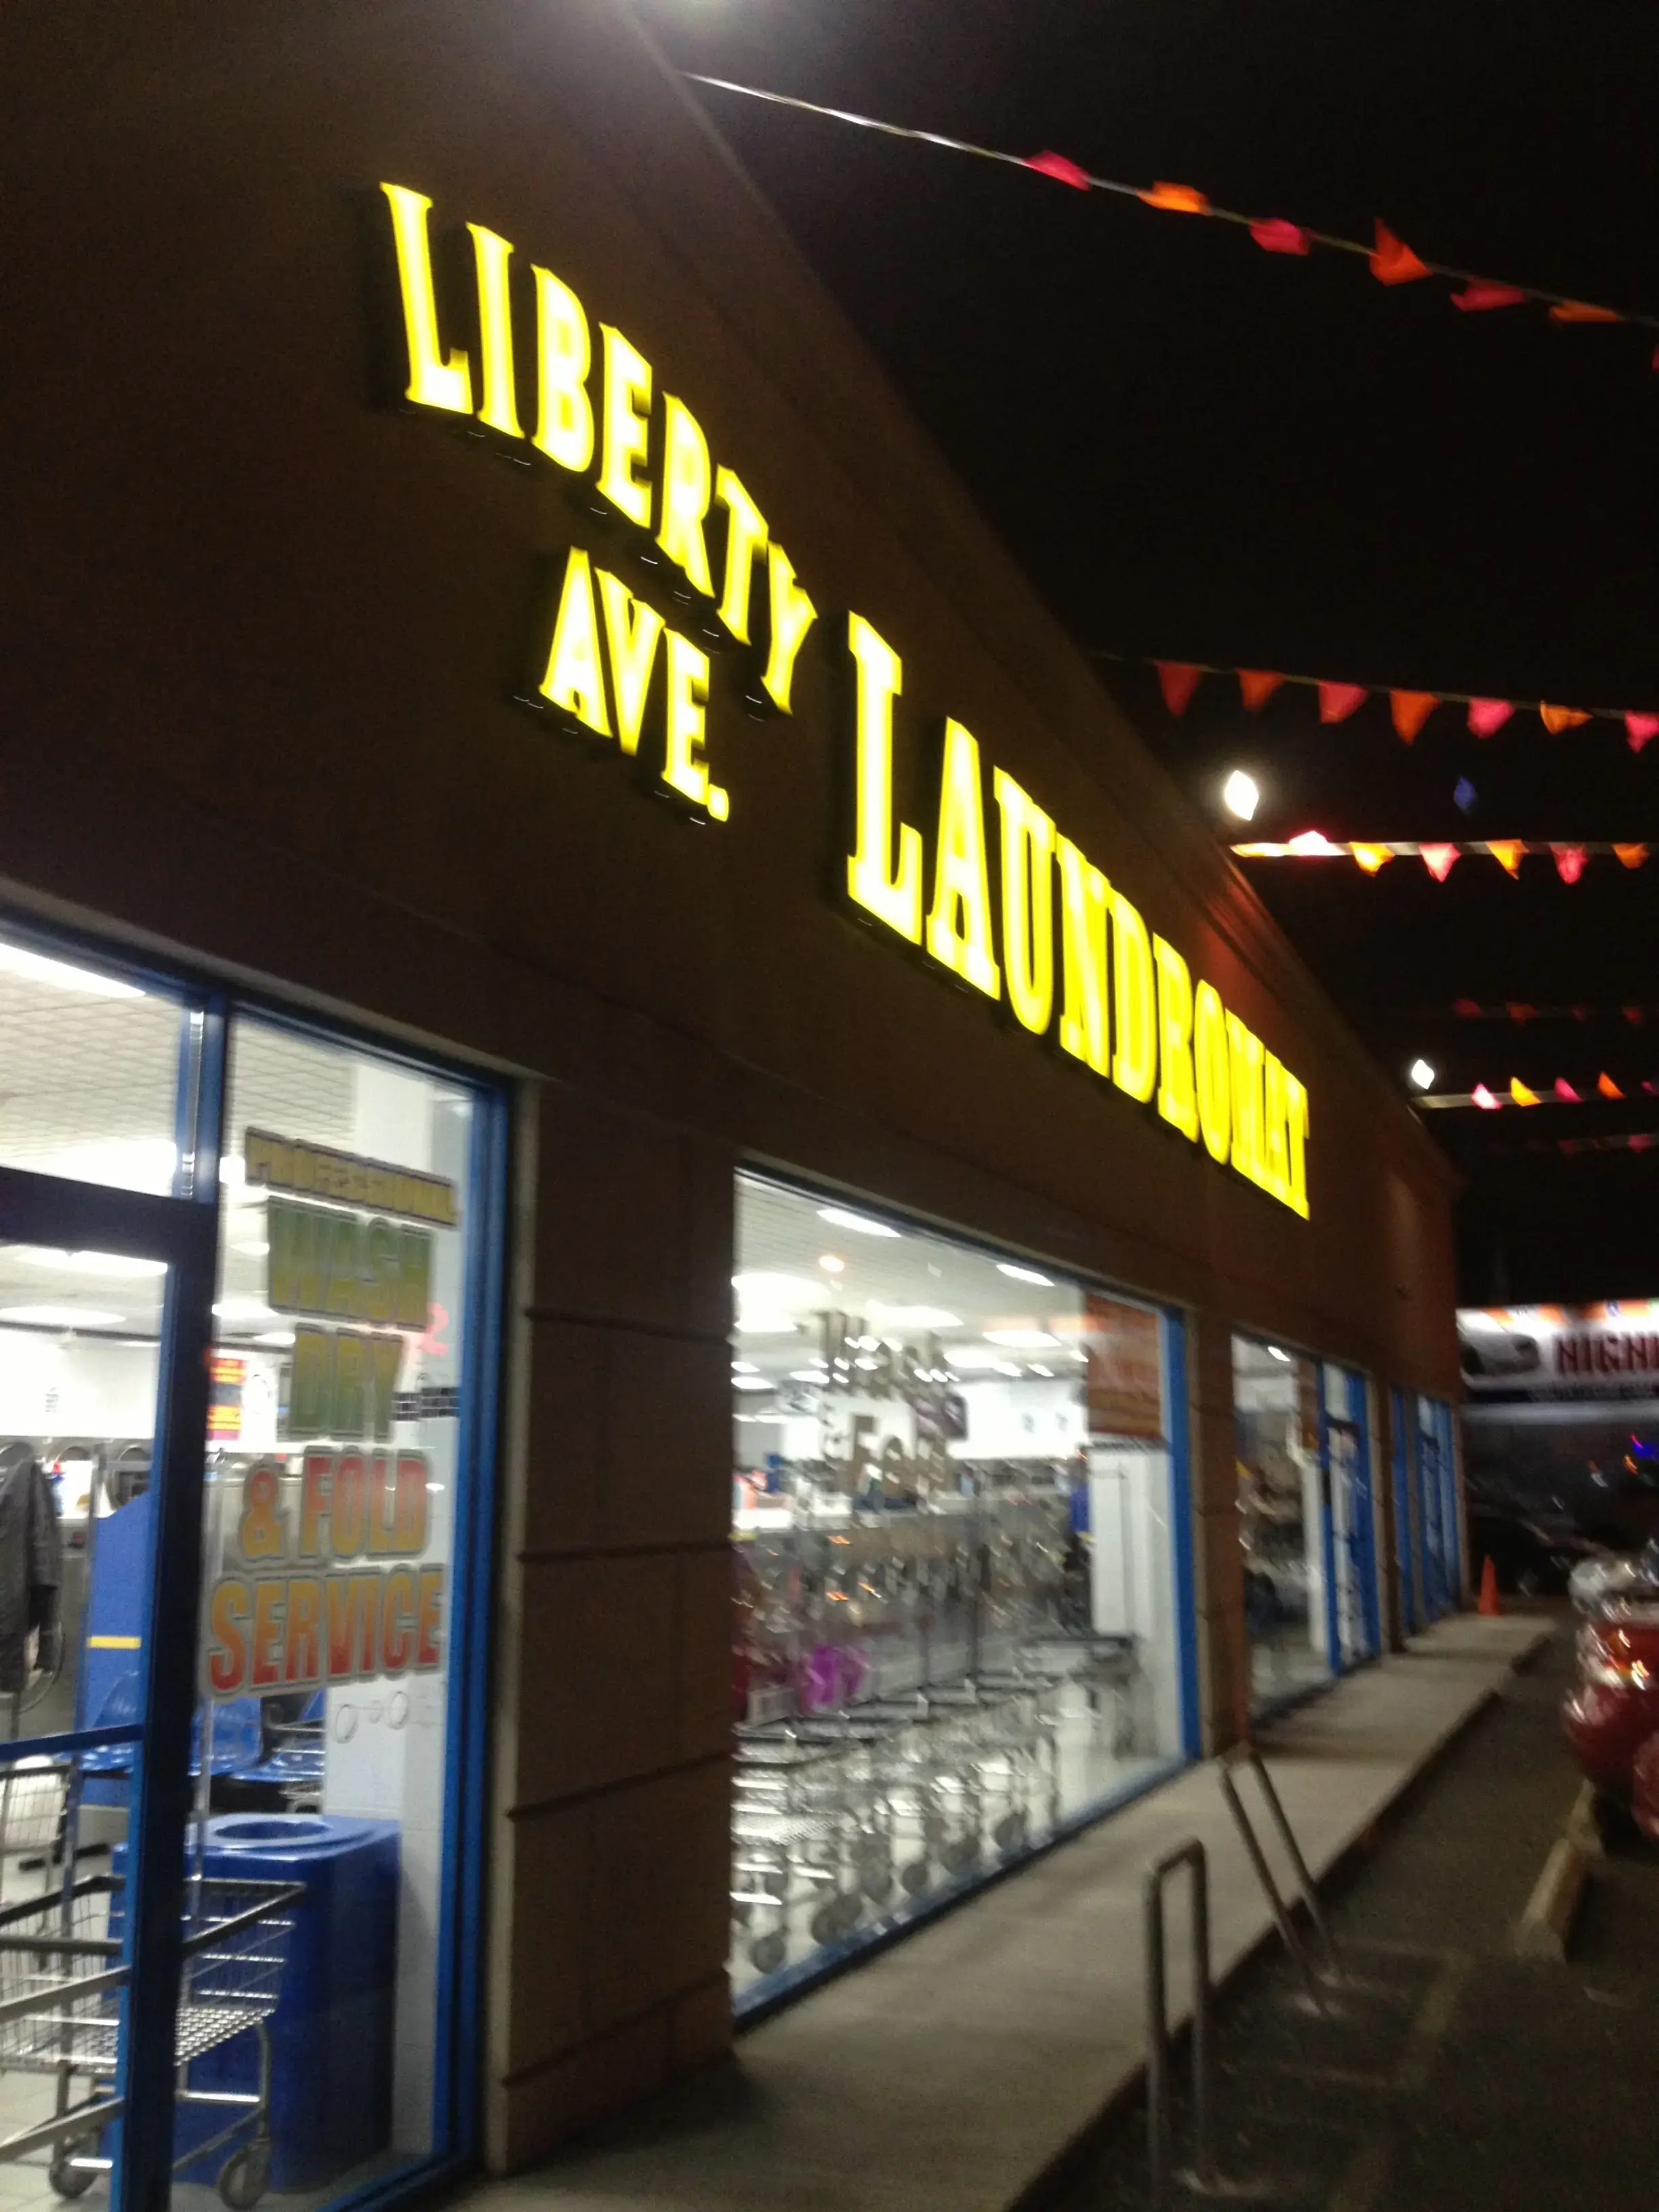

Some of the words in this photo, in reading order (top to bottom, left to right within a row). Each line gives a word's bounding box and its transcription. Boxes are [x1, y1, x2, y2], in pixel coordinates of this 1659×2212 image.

[380, 181, 817, 715] LIBERTY
[539, 546, 730, 822] AVE.
[847, 610, 1309, 1220] LAUNDROMAT
[268, 1197, 432, 1330] WASH
[290, 1324, 405, 1441] DRY
[240, 1466, 286, 1561] &
[300, 1449, 431, 1560] FOLD
[206, 1565, 445, 1696] SERVICE
